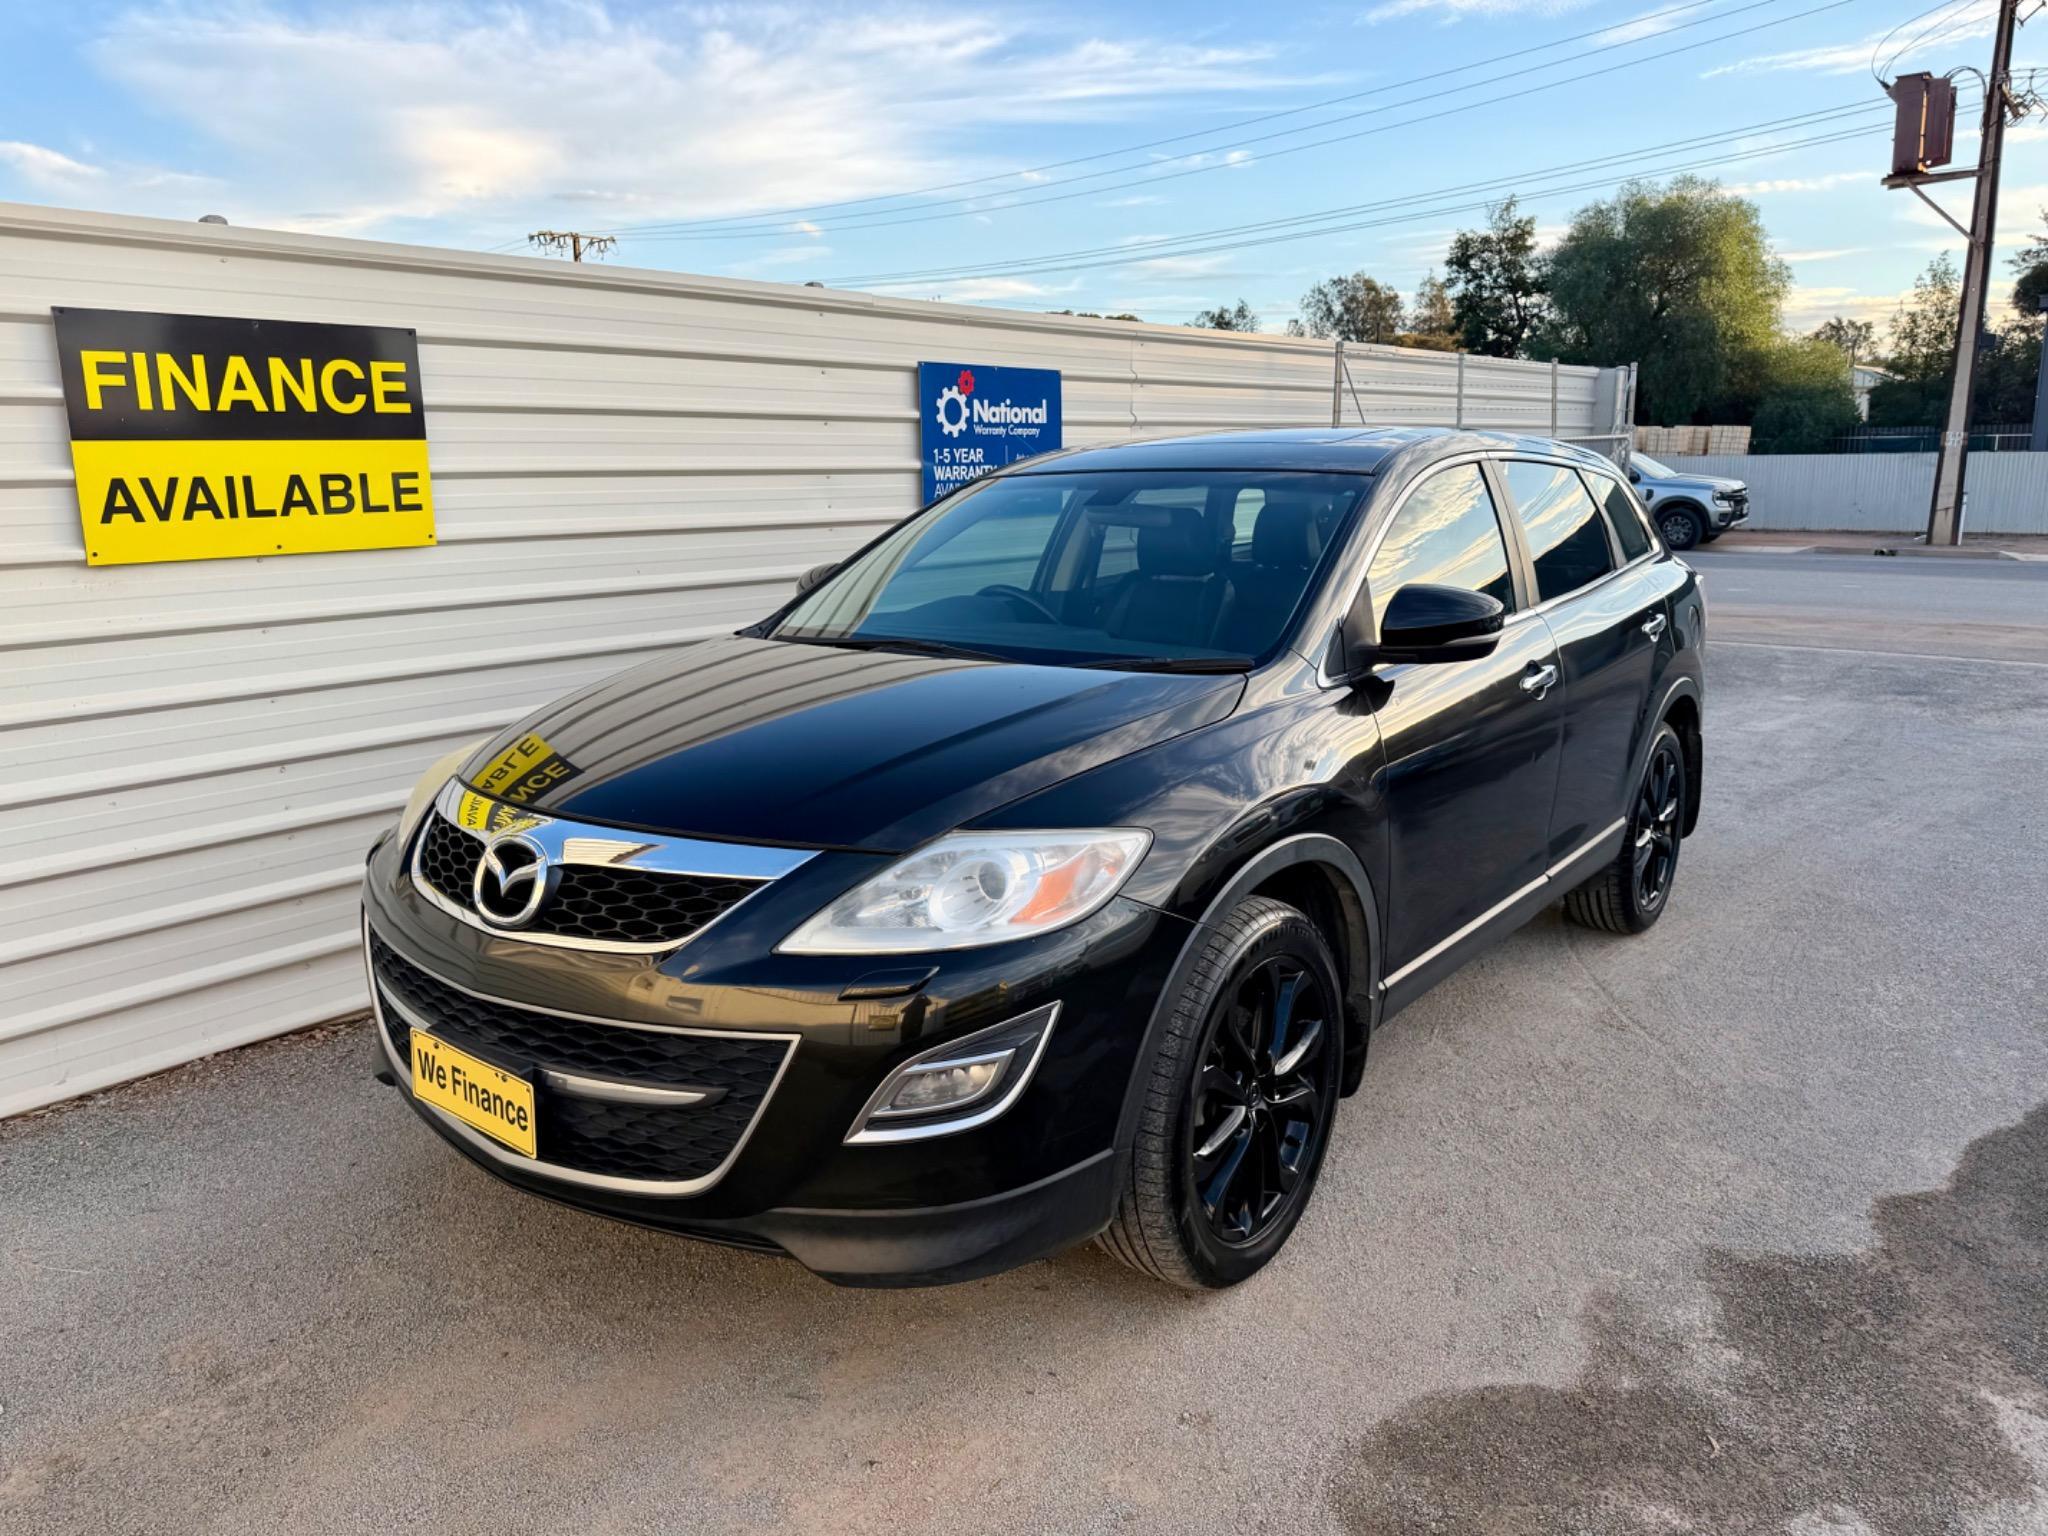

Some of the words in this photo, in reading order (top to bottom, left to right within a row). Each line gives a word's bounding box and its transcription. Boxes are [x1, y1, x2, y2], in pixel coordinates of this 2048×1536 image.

[80, 350, 412, 414] FINANCE
[973, 398, 1047, 423] National
[974, 424, 1007, 438] Warranty
[1008, 424, 1040, 438] Company
[933, 448, 951, 464] 1-5
[953, 448, 984, 463] YEAR
[100, 472, 424, 524] AVAILABLE
[417, 1048, 447, 1090] We
[451, 1065, 529, 1132] Finance
